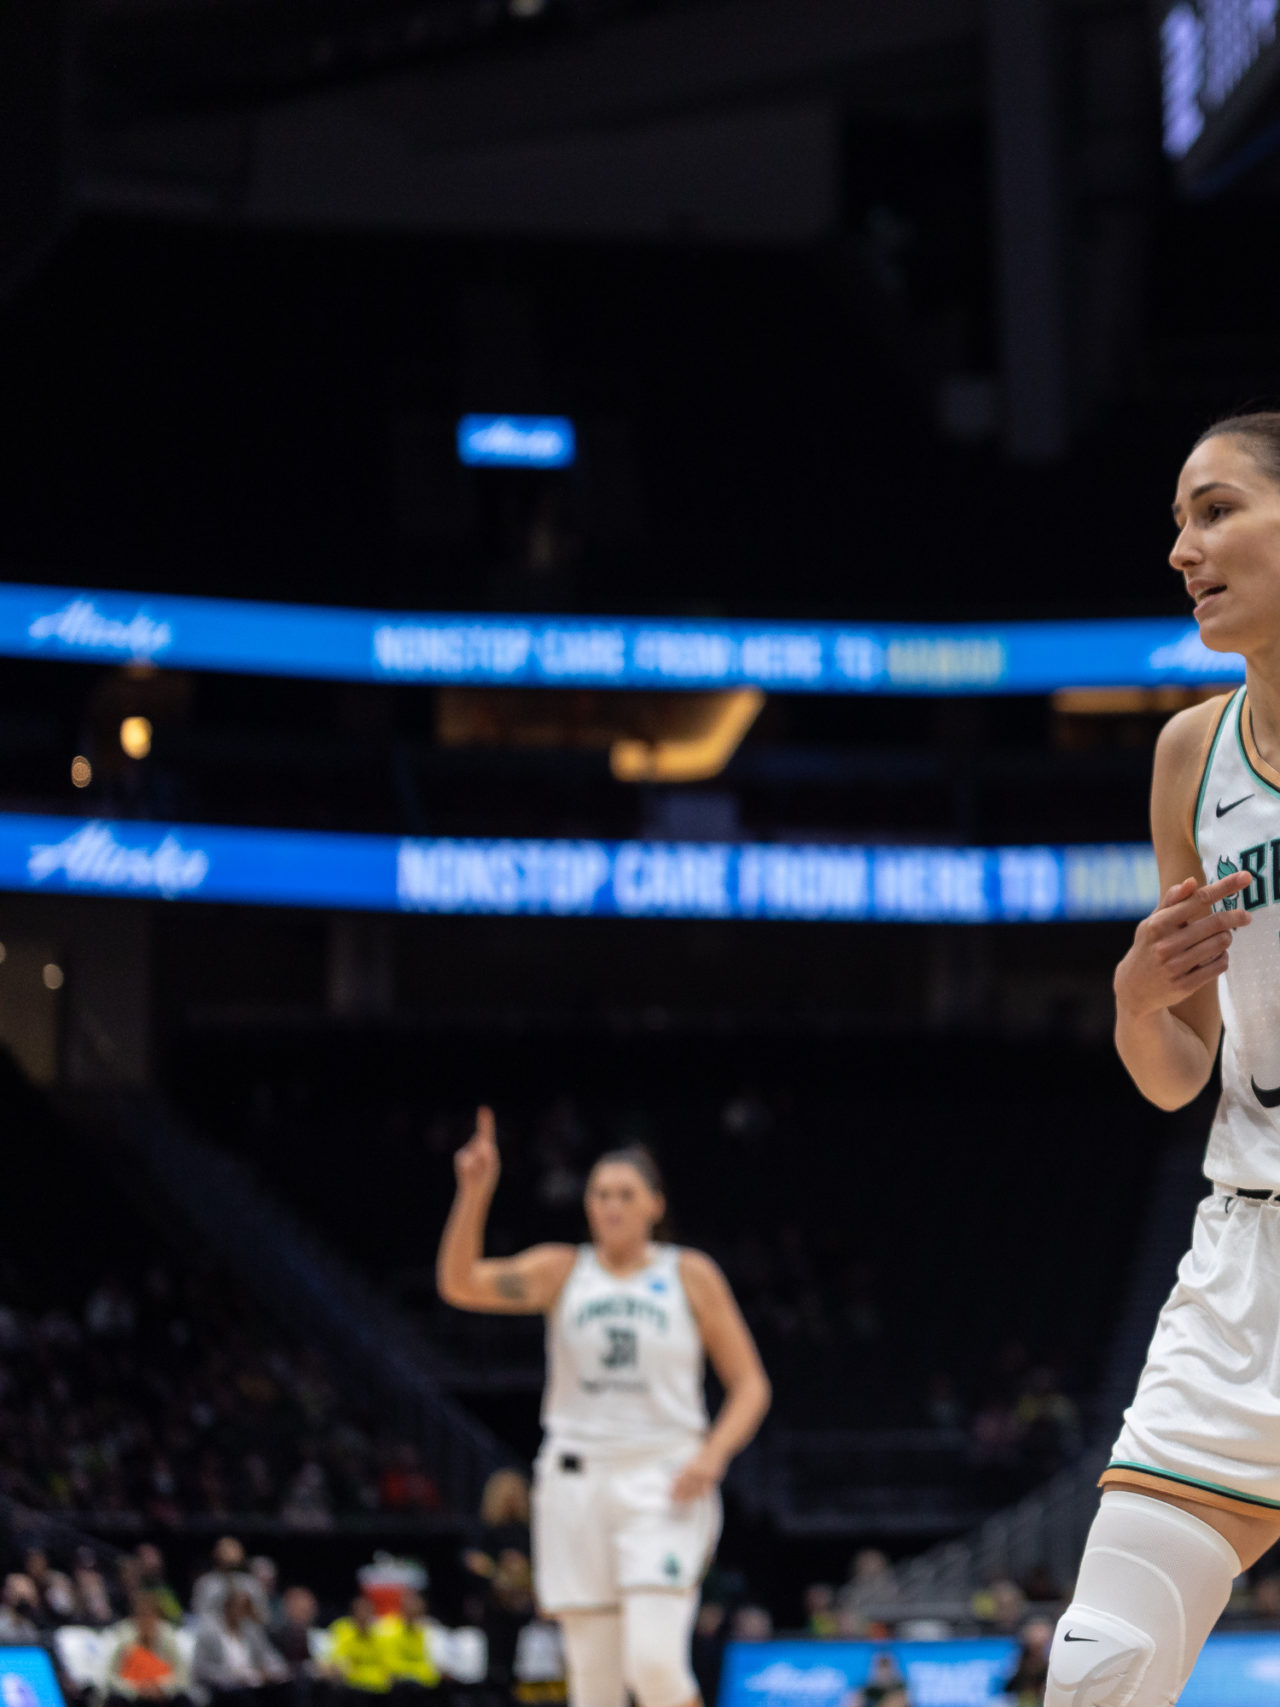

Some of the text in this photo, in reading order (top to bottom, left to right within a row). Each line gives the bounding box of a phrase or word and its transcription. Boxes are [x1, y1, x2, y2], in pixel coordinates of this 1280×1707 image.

[397, 840, 609, 911] NONSTOP
[613, 843, 727, 914] CARE
[738, 845, 868, 917] FROM
[874, 848, 985, 918] HERE
